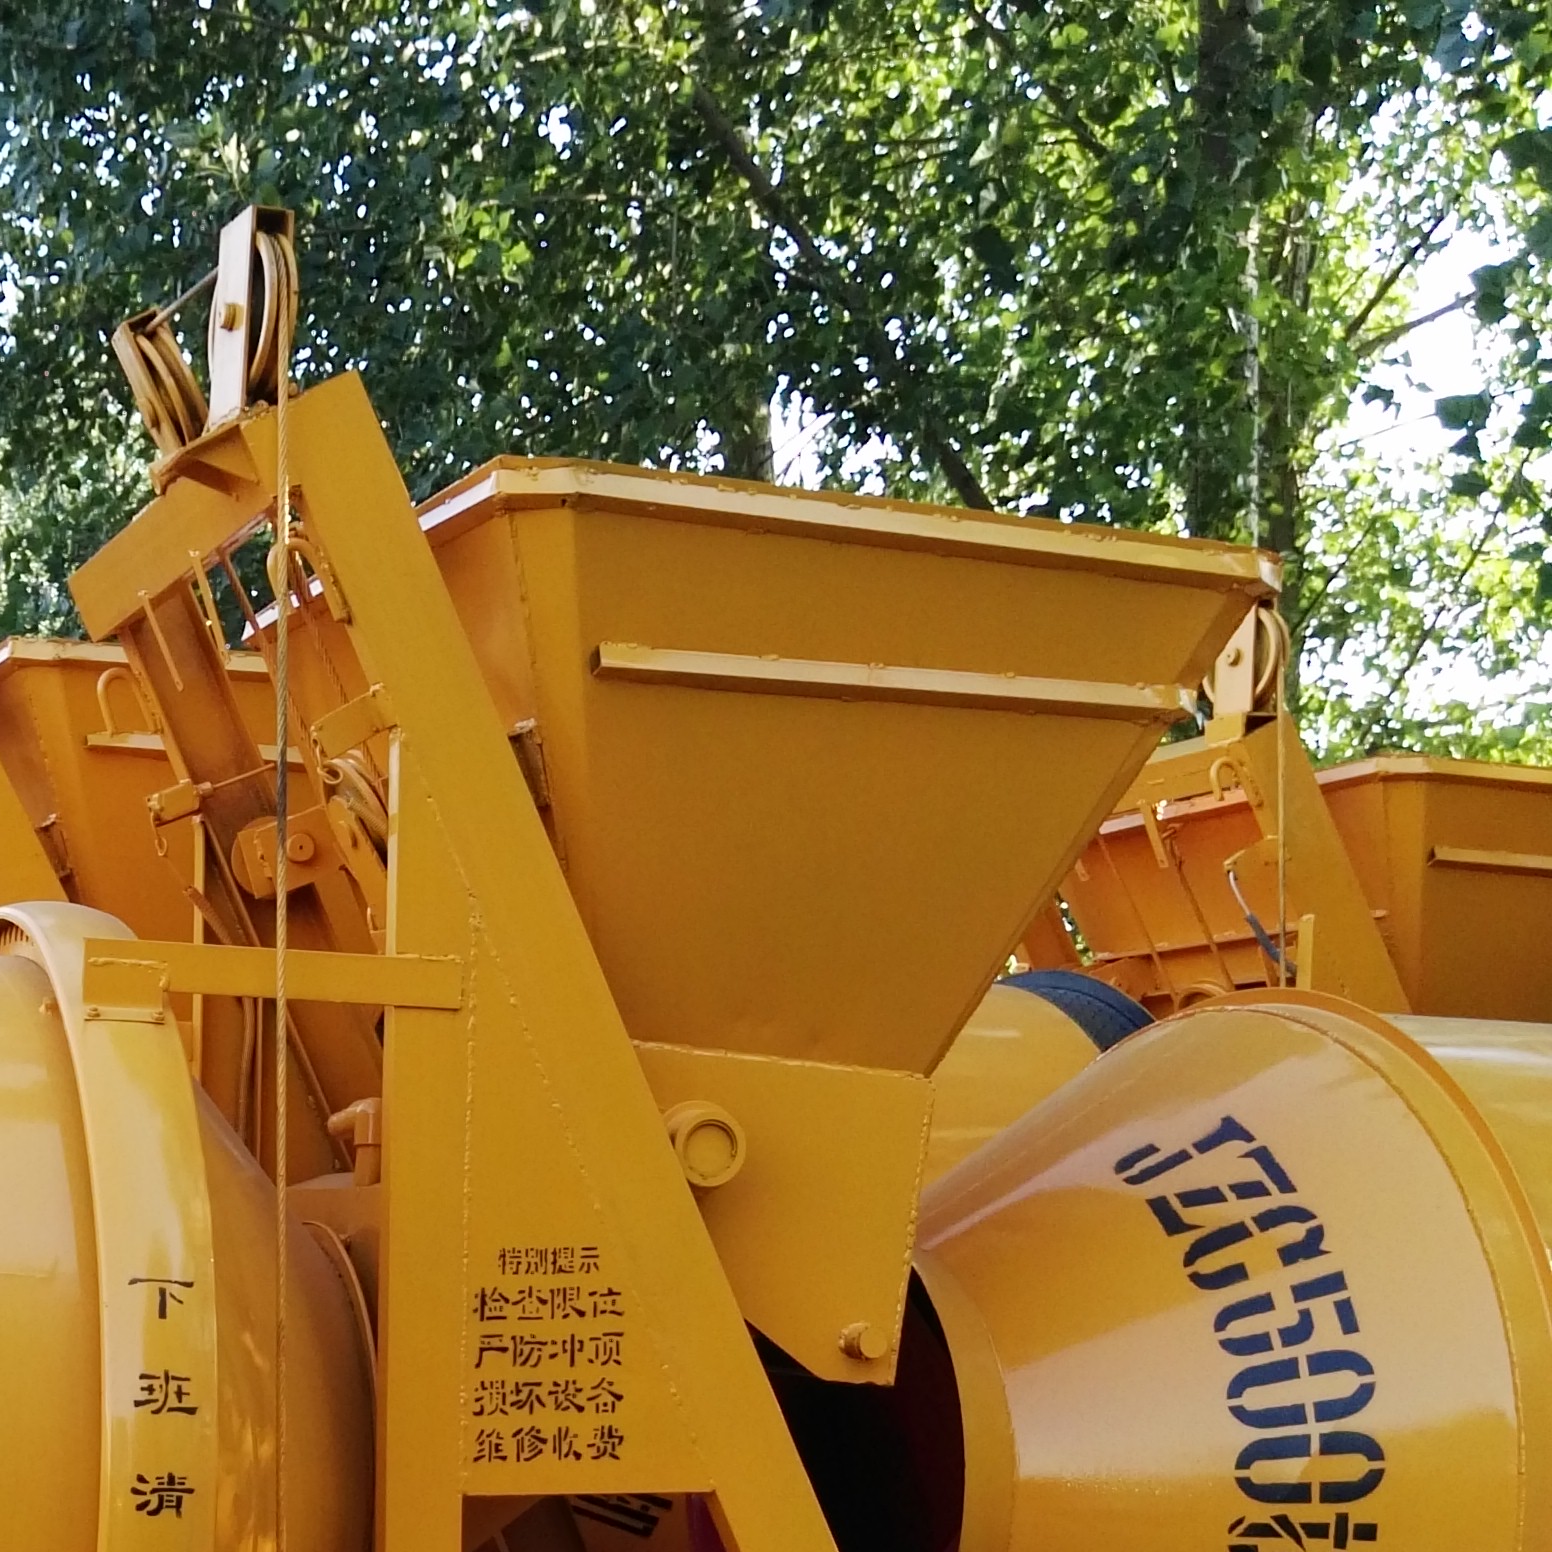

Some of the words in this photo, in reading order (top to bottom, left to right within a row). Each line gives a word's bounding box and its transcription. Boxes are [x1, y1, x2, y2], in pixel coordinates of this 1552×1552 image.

[498, 1247, 600, 1275] 特别提示
[472, 1286, 625, 1322] 检查限位
[474, 1332, 625, 1368] 严防冲顶
[472, 1377, 624, 1417] 损坏设备
[472, 1425, 625, 1463] 维修收费
